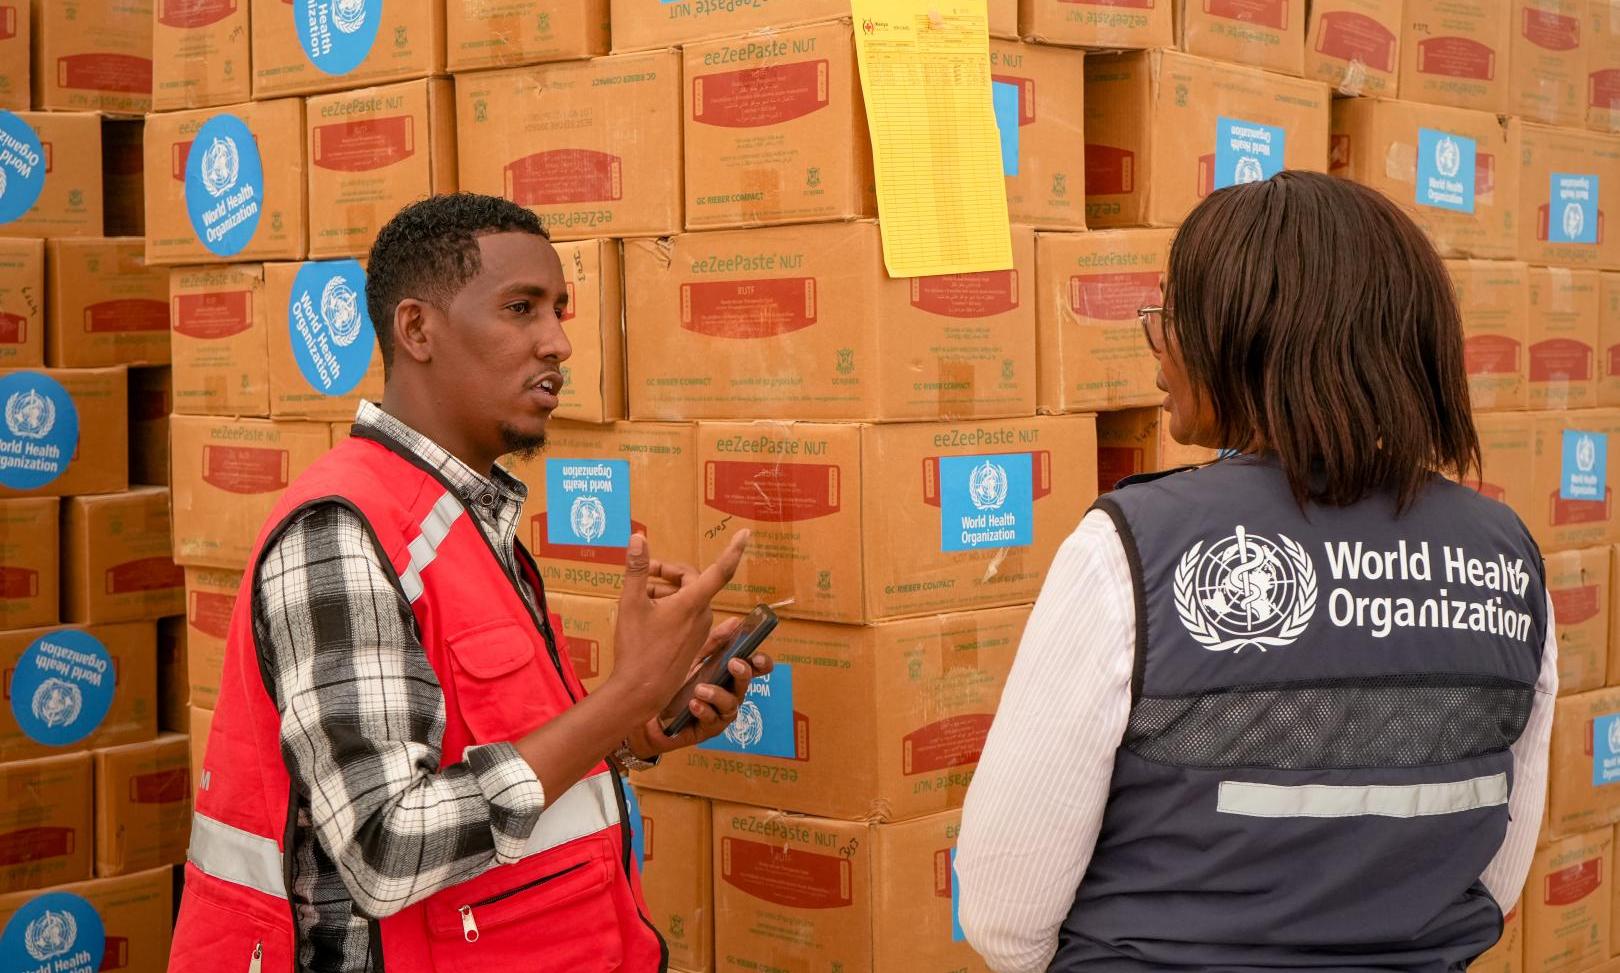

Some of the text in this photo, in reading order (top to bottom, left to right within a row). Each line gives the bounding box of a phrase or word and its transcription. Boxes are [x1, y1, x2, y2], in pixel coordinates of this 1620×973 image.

[704, 37, 817, 66] eeZeePaste NUT
[1002, 53, 1024, 68] NUT
[320, 95, 404, 119] eeZeePaste NUT
[202, 182, 255, 227] World Health
[206, 205, 259, 243] Organization
[690, 254, 805, 275] eeZeePaste NUT
[292, 301, 332, 390] Organization
[300, 291, 341, 380] World Health
[210, 427, 264, 441] eeZeePaste
[933, 428, 1040, 448] eeZeePaste NUT
[0, 438, 60, 459] orld Health
[716, 435, 828, 456] eeZeePaste NUT
[562, 464, 613, 479] Organization
[563, 479, 612, 493] World Health
[961, 512, 1015, 530] World Health
[961, 528, 1016, 547] Organization
[1323, 539, 1530, 599] World Health
[922, 579, 956, 591] COMPACT
[1328, 587, 1532, 643] Organization
[40, 641, 107, 673] Organization
[35, 654, 102, 688] World Health
[687, 752, 799, 784] eeZeePaste NUT
[912, 778, 932, 794] NUT
[731, 815, 839, 848] eeZeePaste NUT
[54, 950, 91, 972] Health
